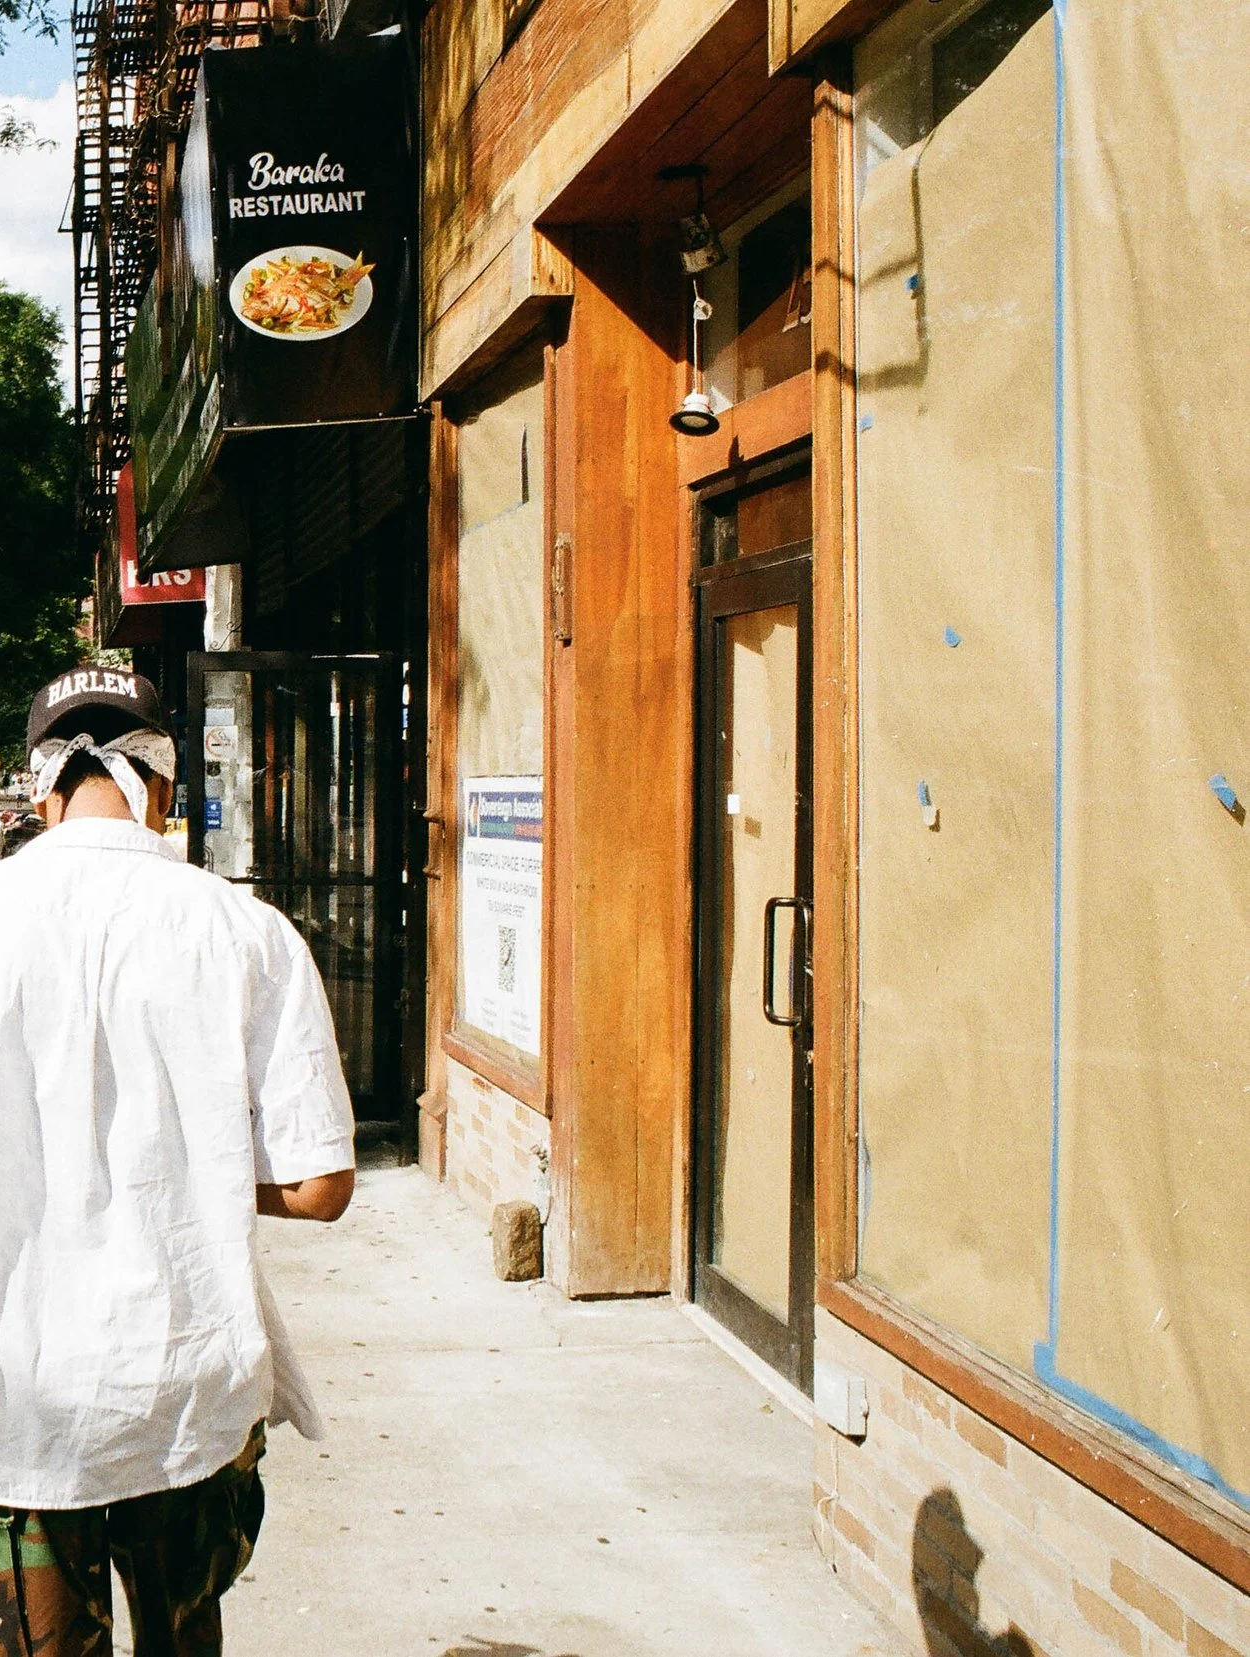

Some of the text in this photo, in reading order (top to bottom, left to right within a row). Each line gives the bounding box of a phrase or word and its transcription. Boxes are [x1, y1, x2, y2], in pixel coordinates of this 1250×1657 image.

[248, 151, 345, 191] Baraka
[229, 190, 366, 219] RESTAURANT
[46, 671, 138, 708] HARLEM
[513, 797, 542, 819] Associat
